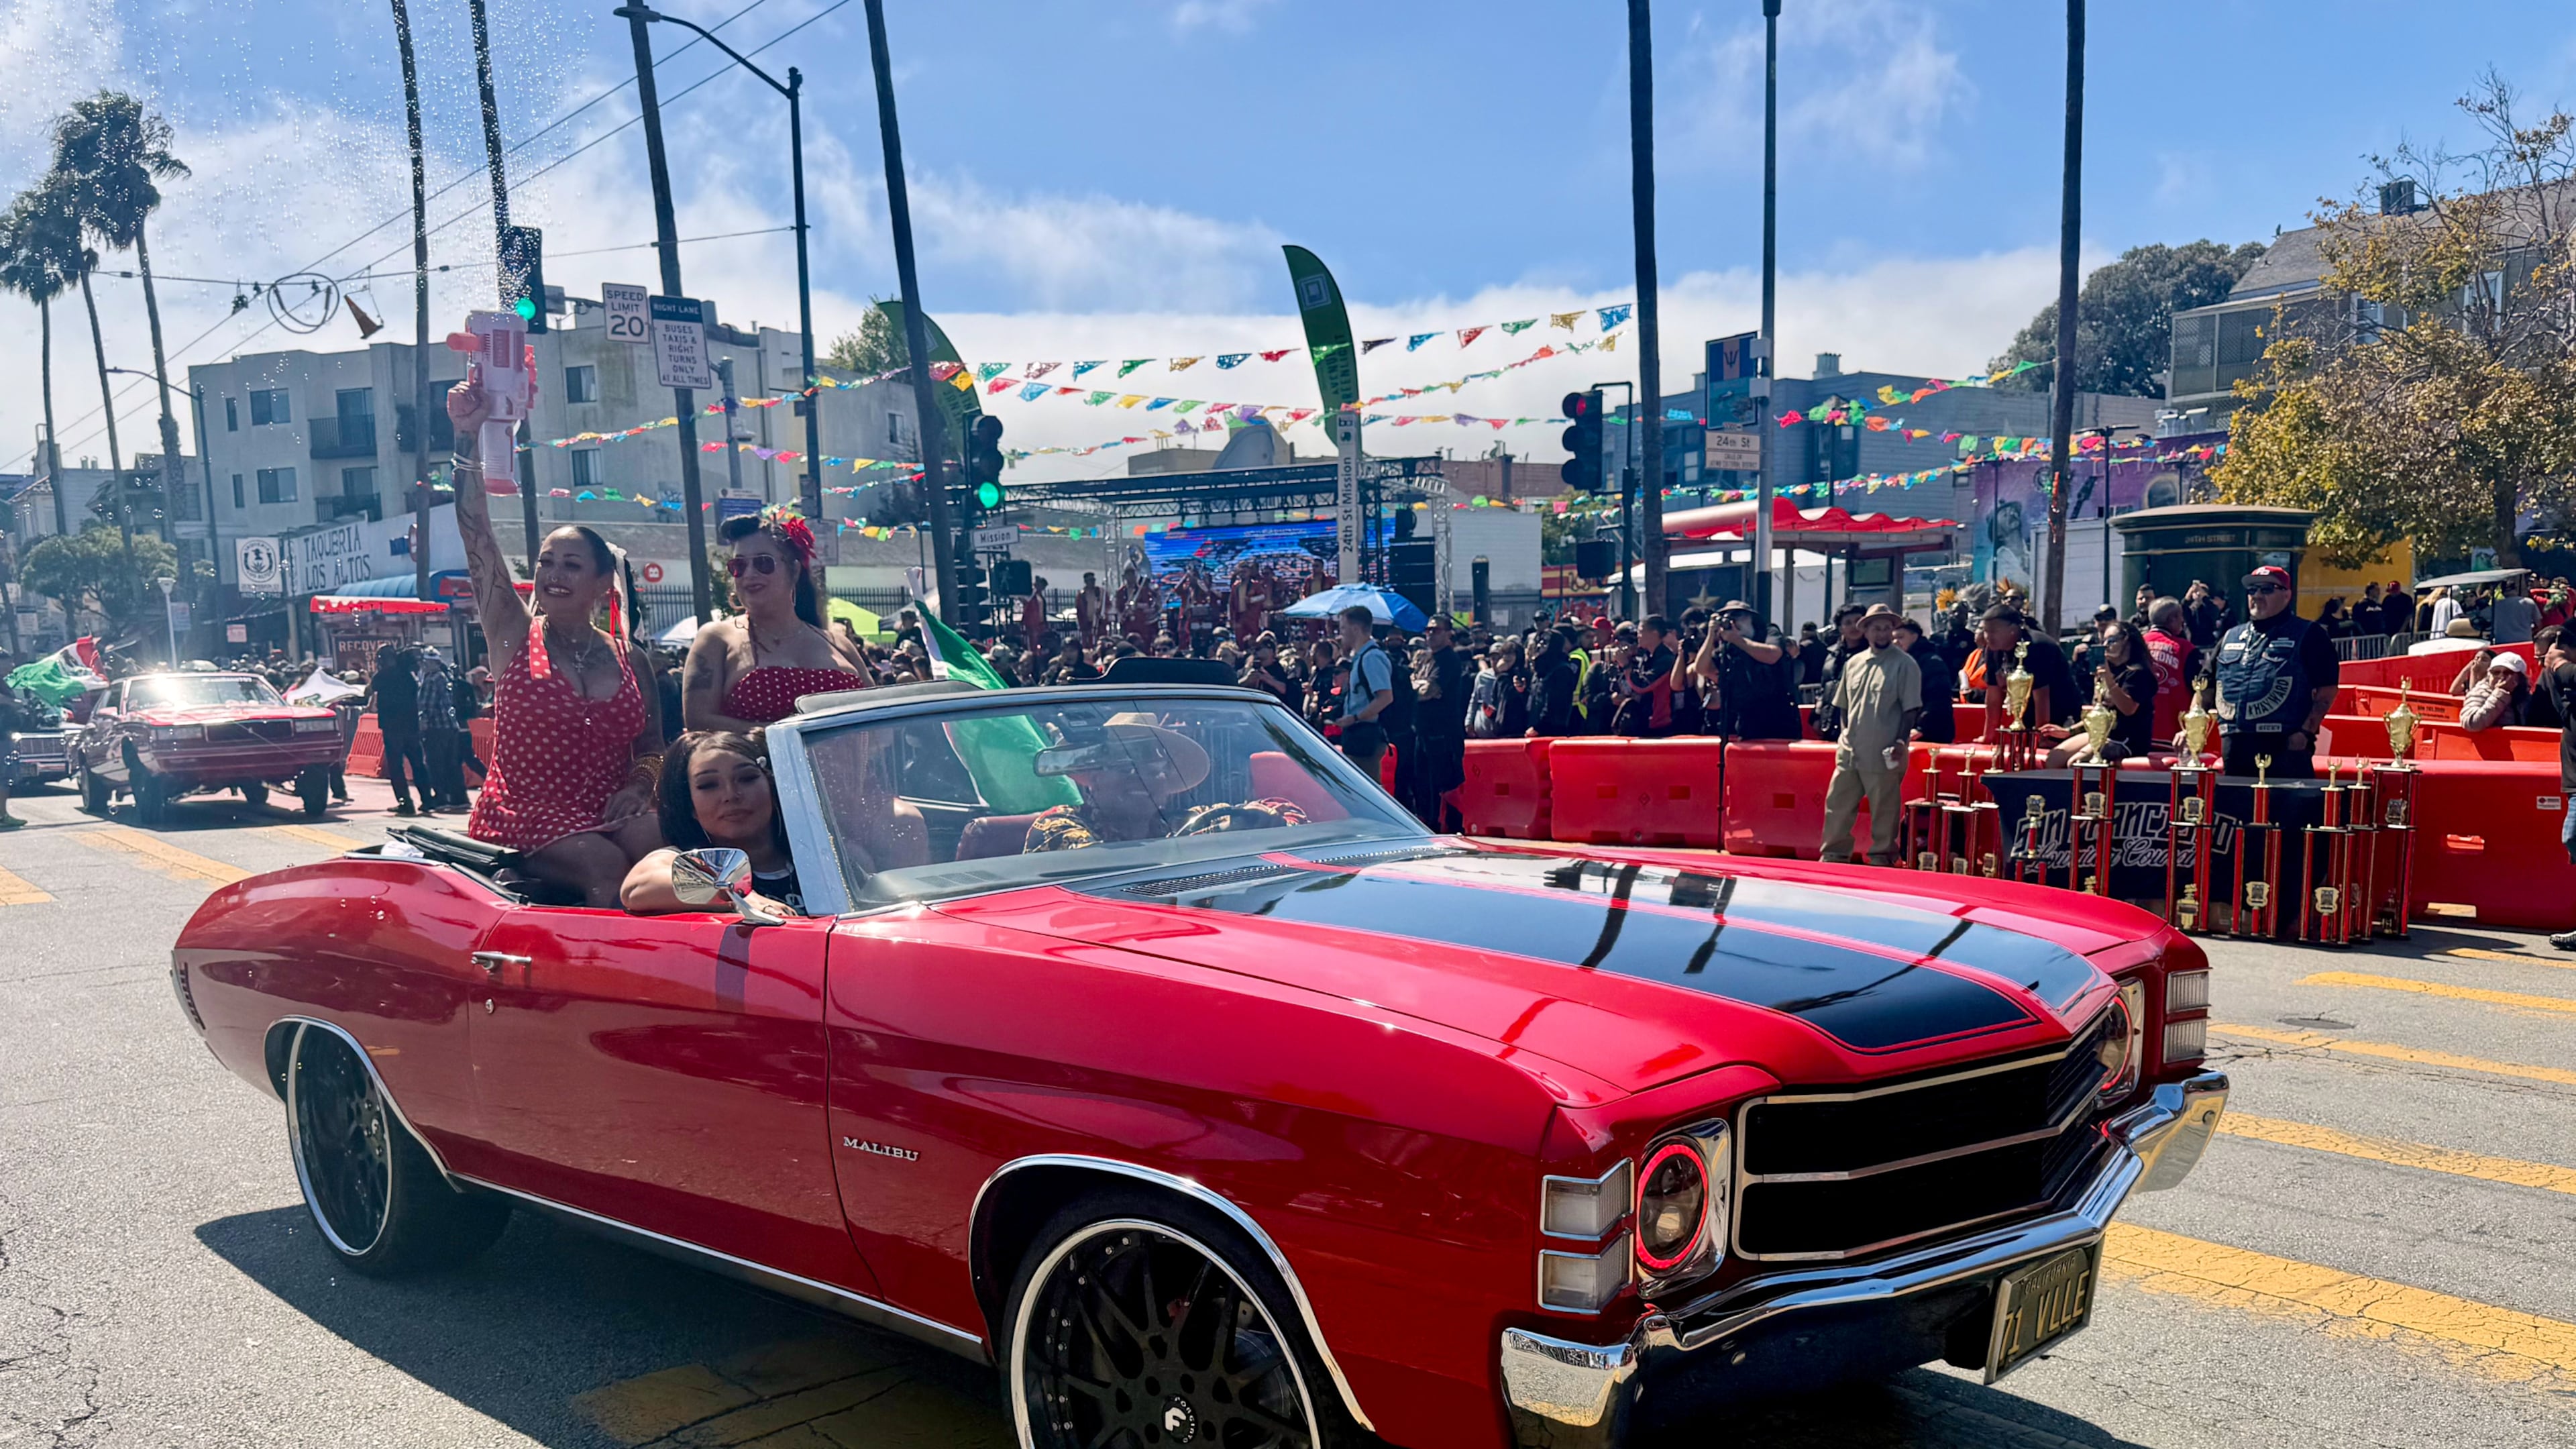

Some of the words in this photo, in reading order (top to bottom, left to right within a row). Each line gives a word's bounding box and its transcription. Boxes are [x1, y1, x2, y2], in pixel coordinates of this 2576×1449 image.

[606, 290, 644, 301] SPEED
[612, 303, 639, 313] LIMIT
[653, 304, 676, 313] RIGHT
[678, 306, 700, 315] LANE
[610, 315, 644, 337] 20
[665, 324, 694, 334] BUSES
[663, 334, 688, 344] TAXIS
[668, 345, 694, 354] RIGHT
[668, 354, 697, 364] TURNS
[672, 365, 695, 374] ONLY
[662, 374, 670, 382] AT
[688, 376, 708, 384] TIMES
[1717, 435, 1736, 447] 24th
[1741, 437, 1750, 448] St
[1342, 457, 1352, 504] Mission
[1342, 508, 1353, 521] St
[980, 531, 1011, 543] Mission
[1343, 525, 1353, 552] 24th
[2207, 534, 2237, 543] STREET
[304, 525, 362, 563] TAQUERIA
[305, 564, 326, 590] LOS
[334, 554, 371, 586] ALTOS
[843, 1136, 919, 1162] MALIBU
[2025, 1255, 2076, 1295] CALIFORNIA
[1998, 1305, 2023, 1363] 71
[2035, 1269, 2091, 1340] VLLE
